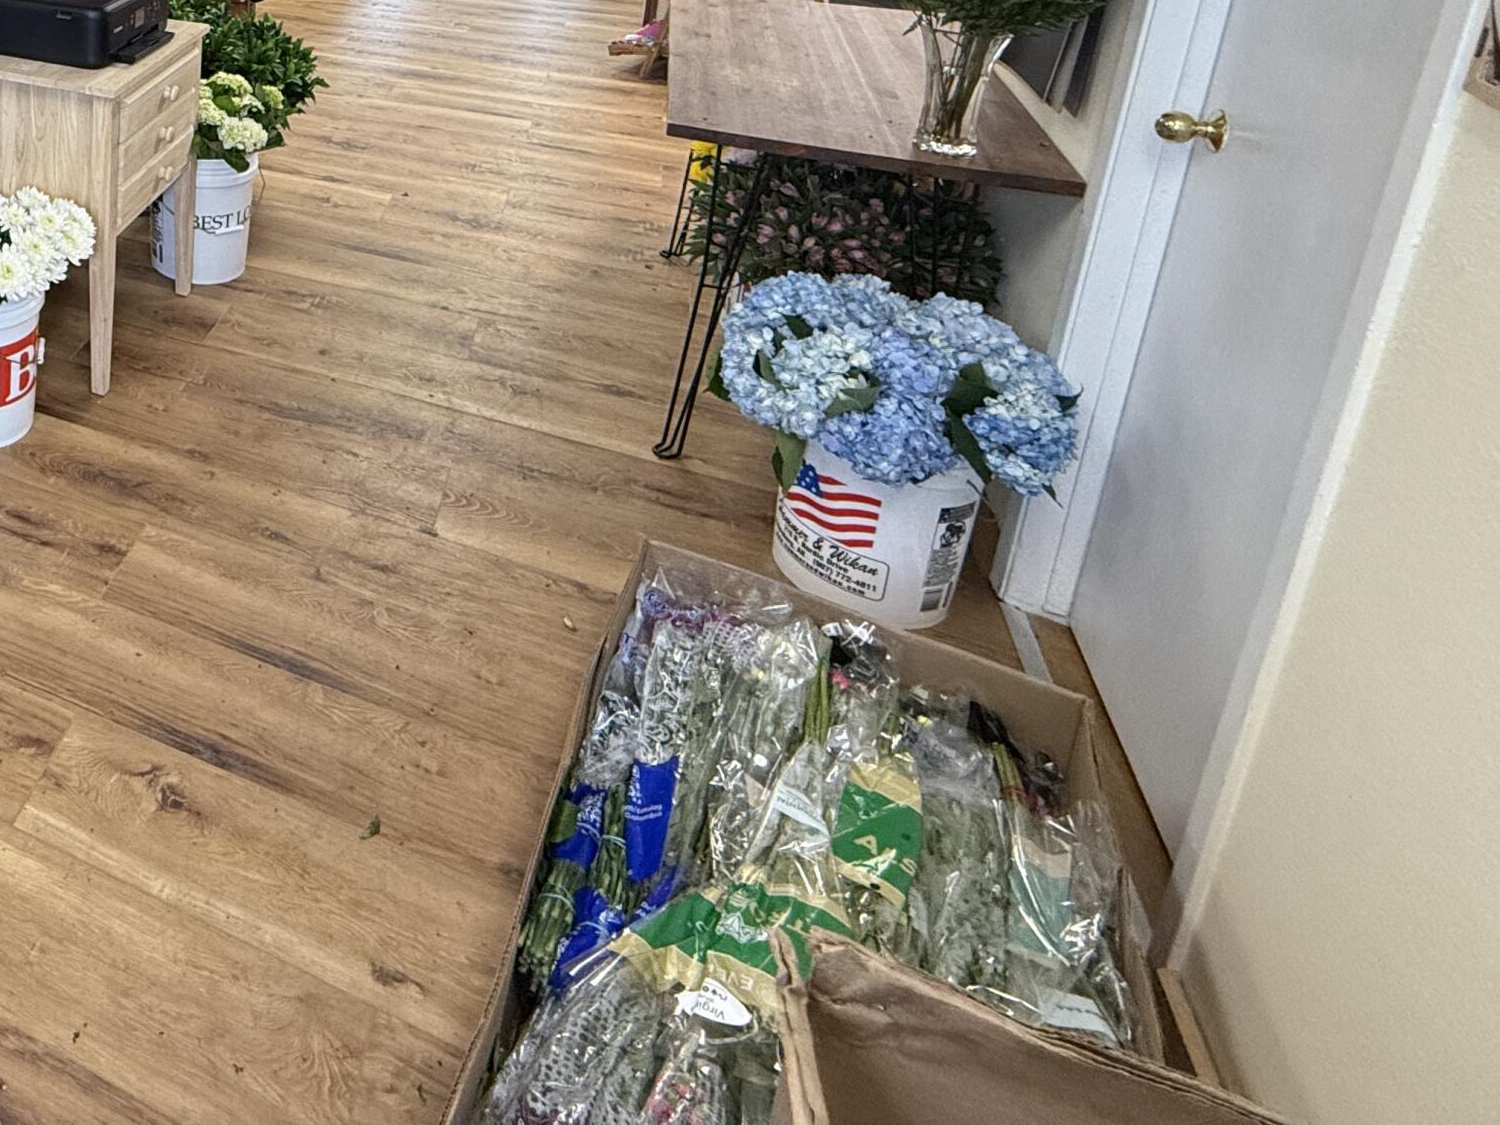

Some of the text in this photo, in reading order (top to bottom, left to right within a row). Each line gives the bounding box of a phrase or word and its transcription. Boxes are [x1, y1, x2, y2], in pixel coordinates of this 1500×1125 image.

[812, 537, 824, 550] &
[829, 544, 878, 576] Wikan
[826, 558, 849, 574] Drive
